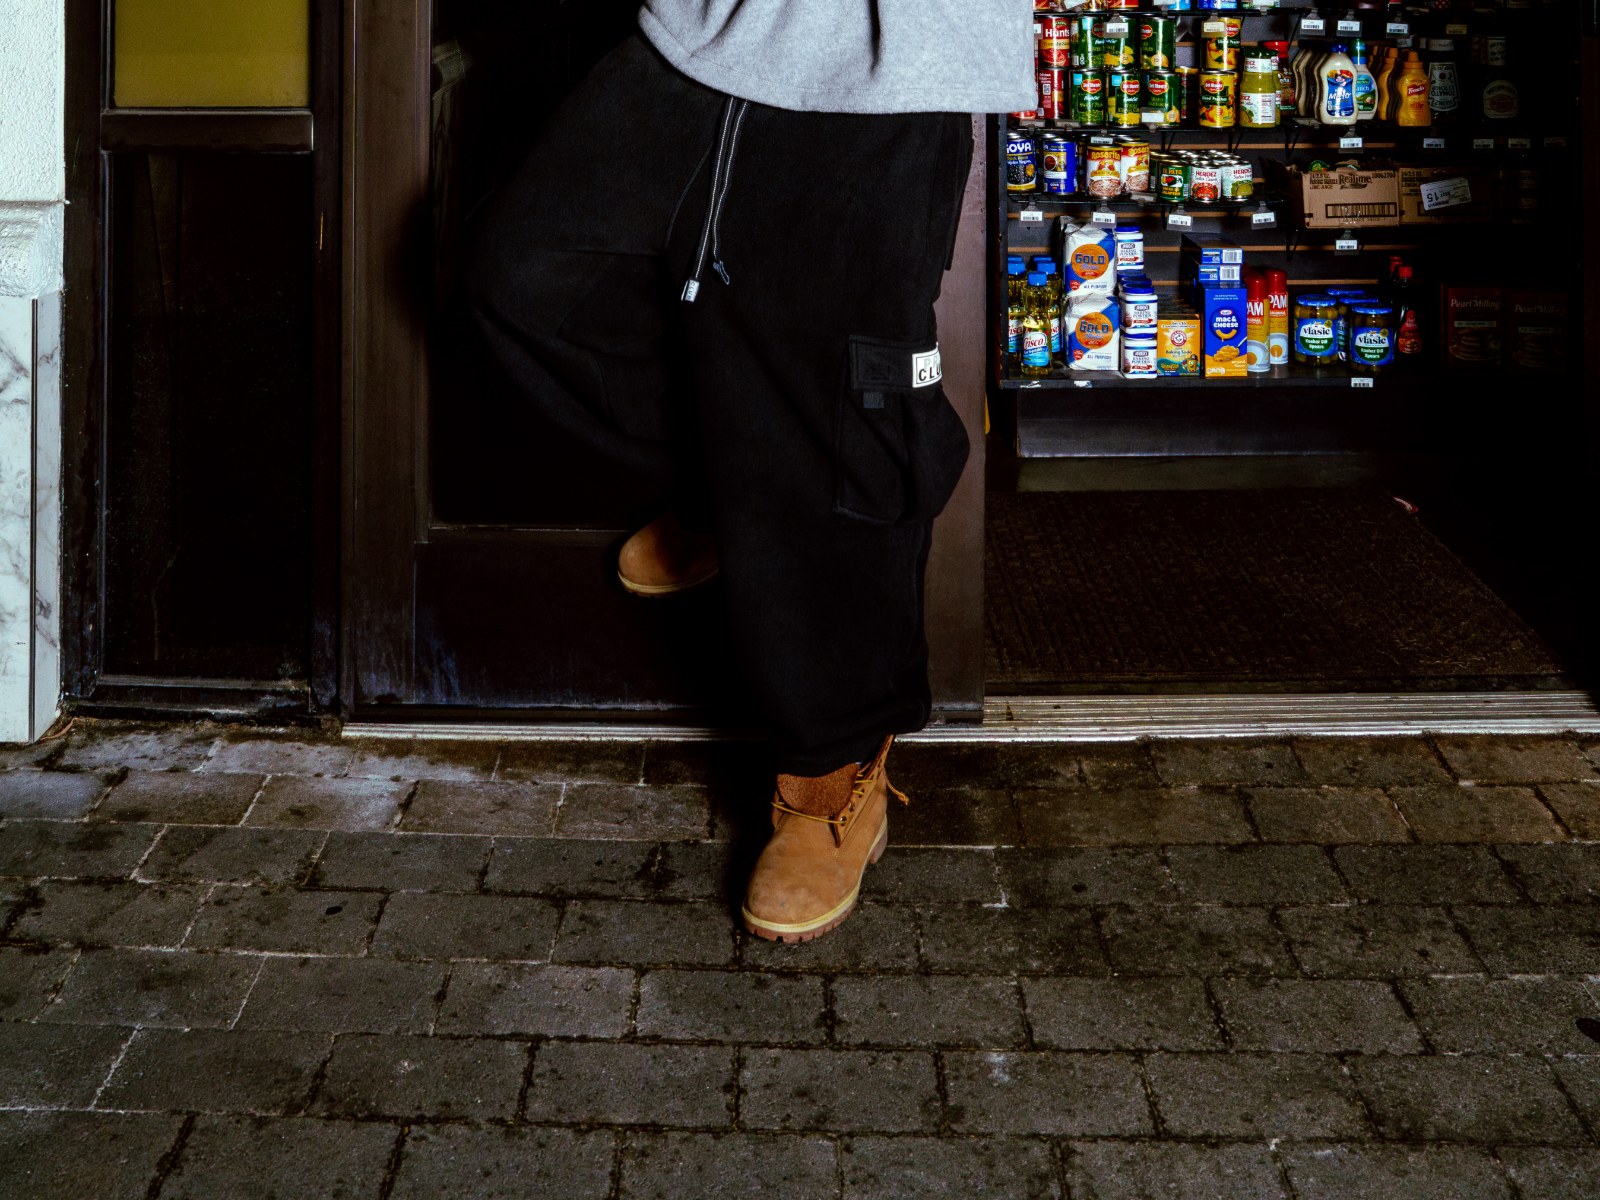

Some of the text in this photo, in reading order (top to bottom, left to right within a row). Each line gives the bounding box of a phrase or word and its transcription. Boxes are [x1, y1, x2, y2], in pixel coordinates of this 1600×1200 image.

[1075, 254, 1105, 264] GOLD
[1268, 295, 1287, 309] PAM
[1080, 322, 1109, 333] GOLD
[1024, 337, 1044, 348] Crisco
